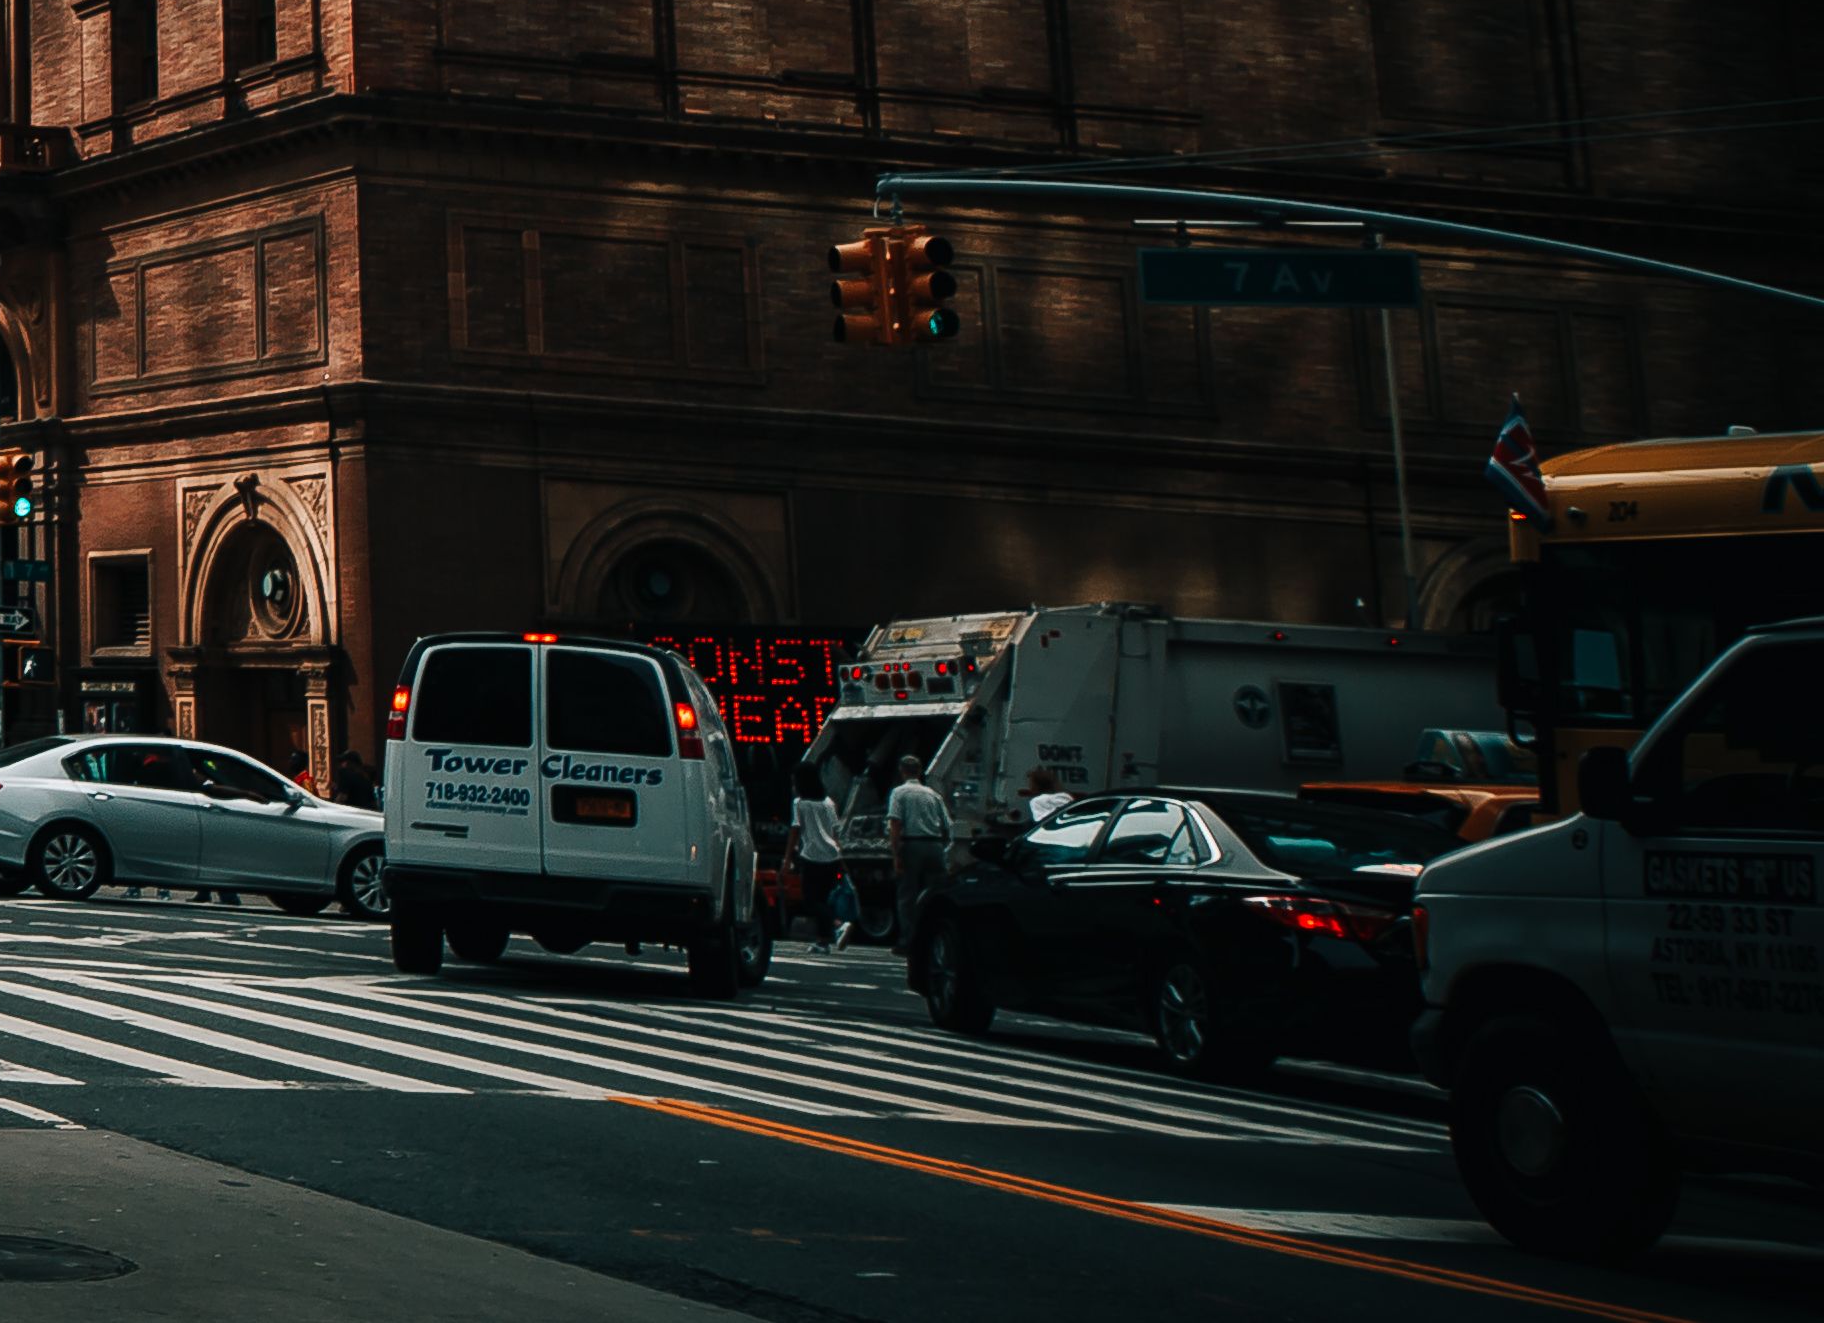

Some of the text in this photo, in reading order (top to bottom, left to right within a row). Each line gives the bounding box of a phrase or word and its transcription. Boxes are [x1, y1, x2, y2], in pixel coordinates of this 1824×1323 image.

[1222, 261, 1335, 294] 7 Av
[425, 748, 664, 786] Tower Cleaners
[425, 781, 531, 807] 718-932-2400
[1647, 855, 1740, 895] GASKETS
[1781, 860, 1812, 898] US
[1764, 908, 1795, 937] ST
